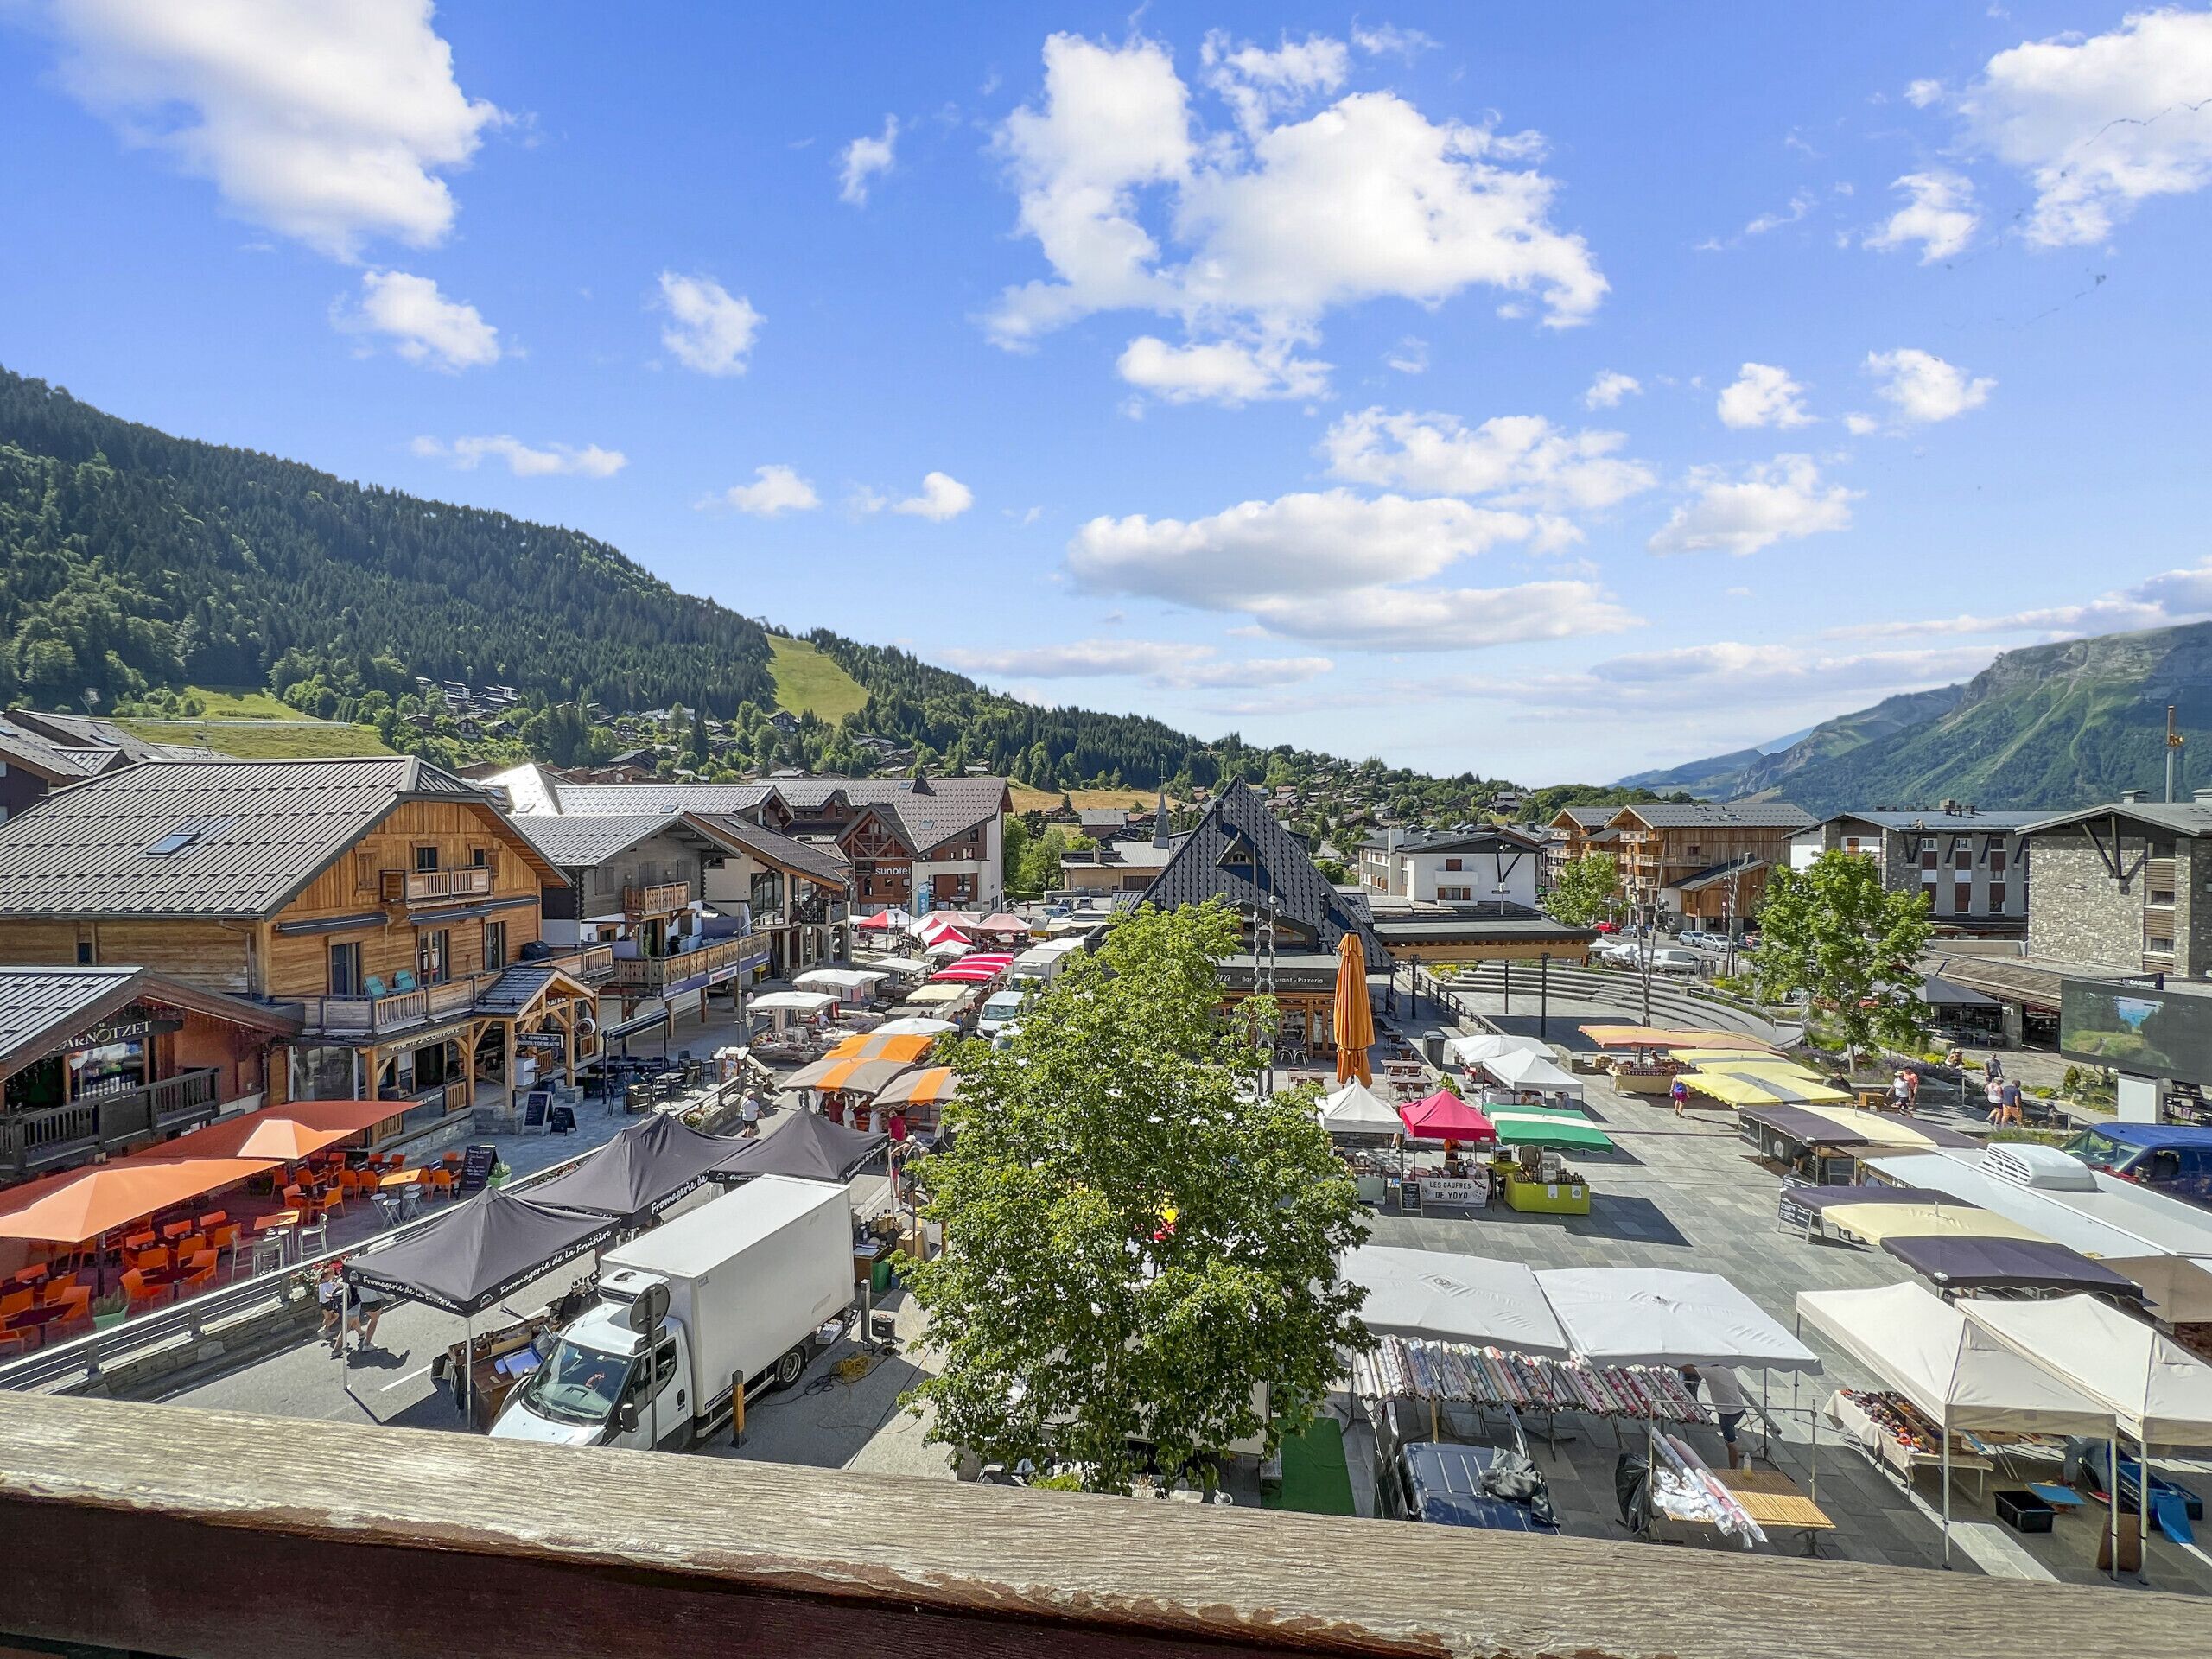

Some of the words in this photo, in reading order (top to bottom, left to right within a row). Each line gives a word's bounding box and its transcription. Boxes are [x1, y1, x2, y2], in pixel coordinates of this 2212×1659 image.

[875, 866, 911, 875] sunotel
[651, 1179, 696, 1214] Fromagerie
[697, 1175, 709, 1187] de
[363, 1275, 404, 1293] Fromagerie
[404, 1287, 415, 1295] de
[499, 1262, 551, 1295] Fromagerie
[551, 1255, 564, 1266] de
[565, 1249, 575, 1259] la
